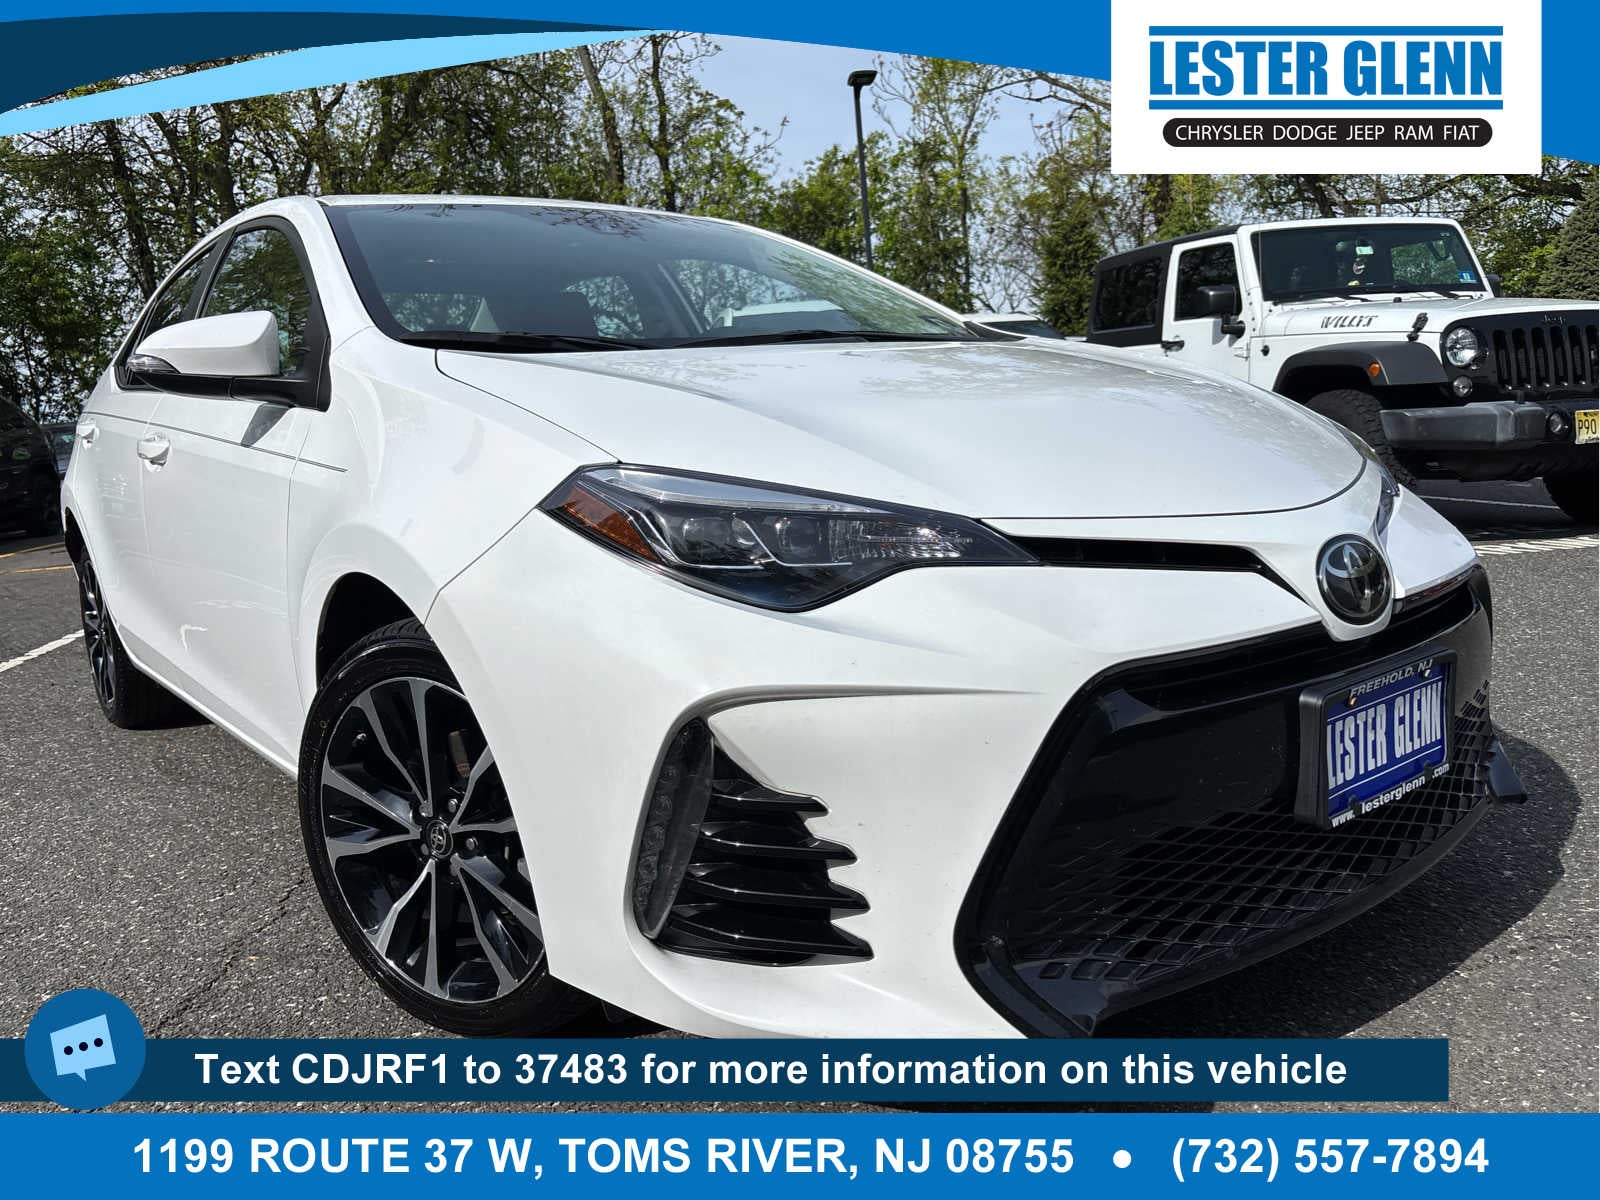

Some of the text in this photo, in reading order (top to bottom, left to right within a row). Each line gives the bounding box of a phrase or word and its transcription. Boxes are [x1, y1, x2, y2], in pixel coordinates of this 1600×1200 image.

[1350, 658, 1434, 698] FREEHOLD, NJ
[1326, 680, 1443, 791] LESTER GLENN
[1331, 762, 1450, 828] www. lesterglenn .com
